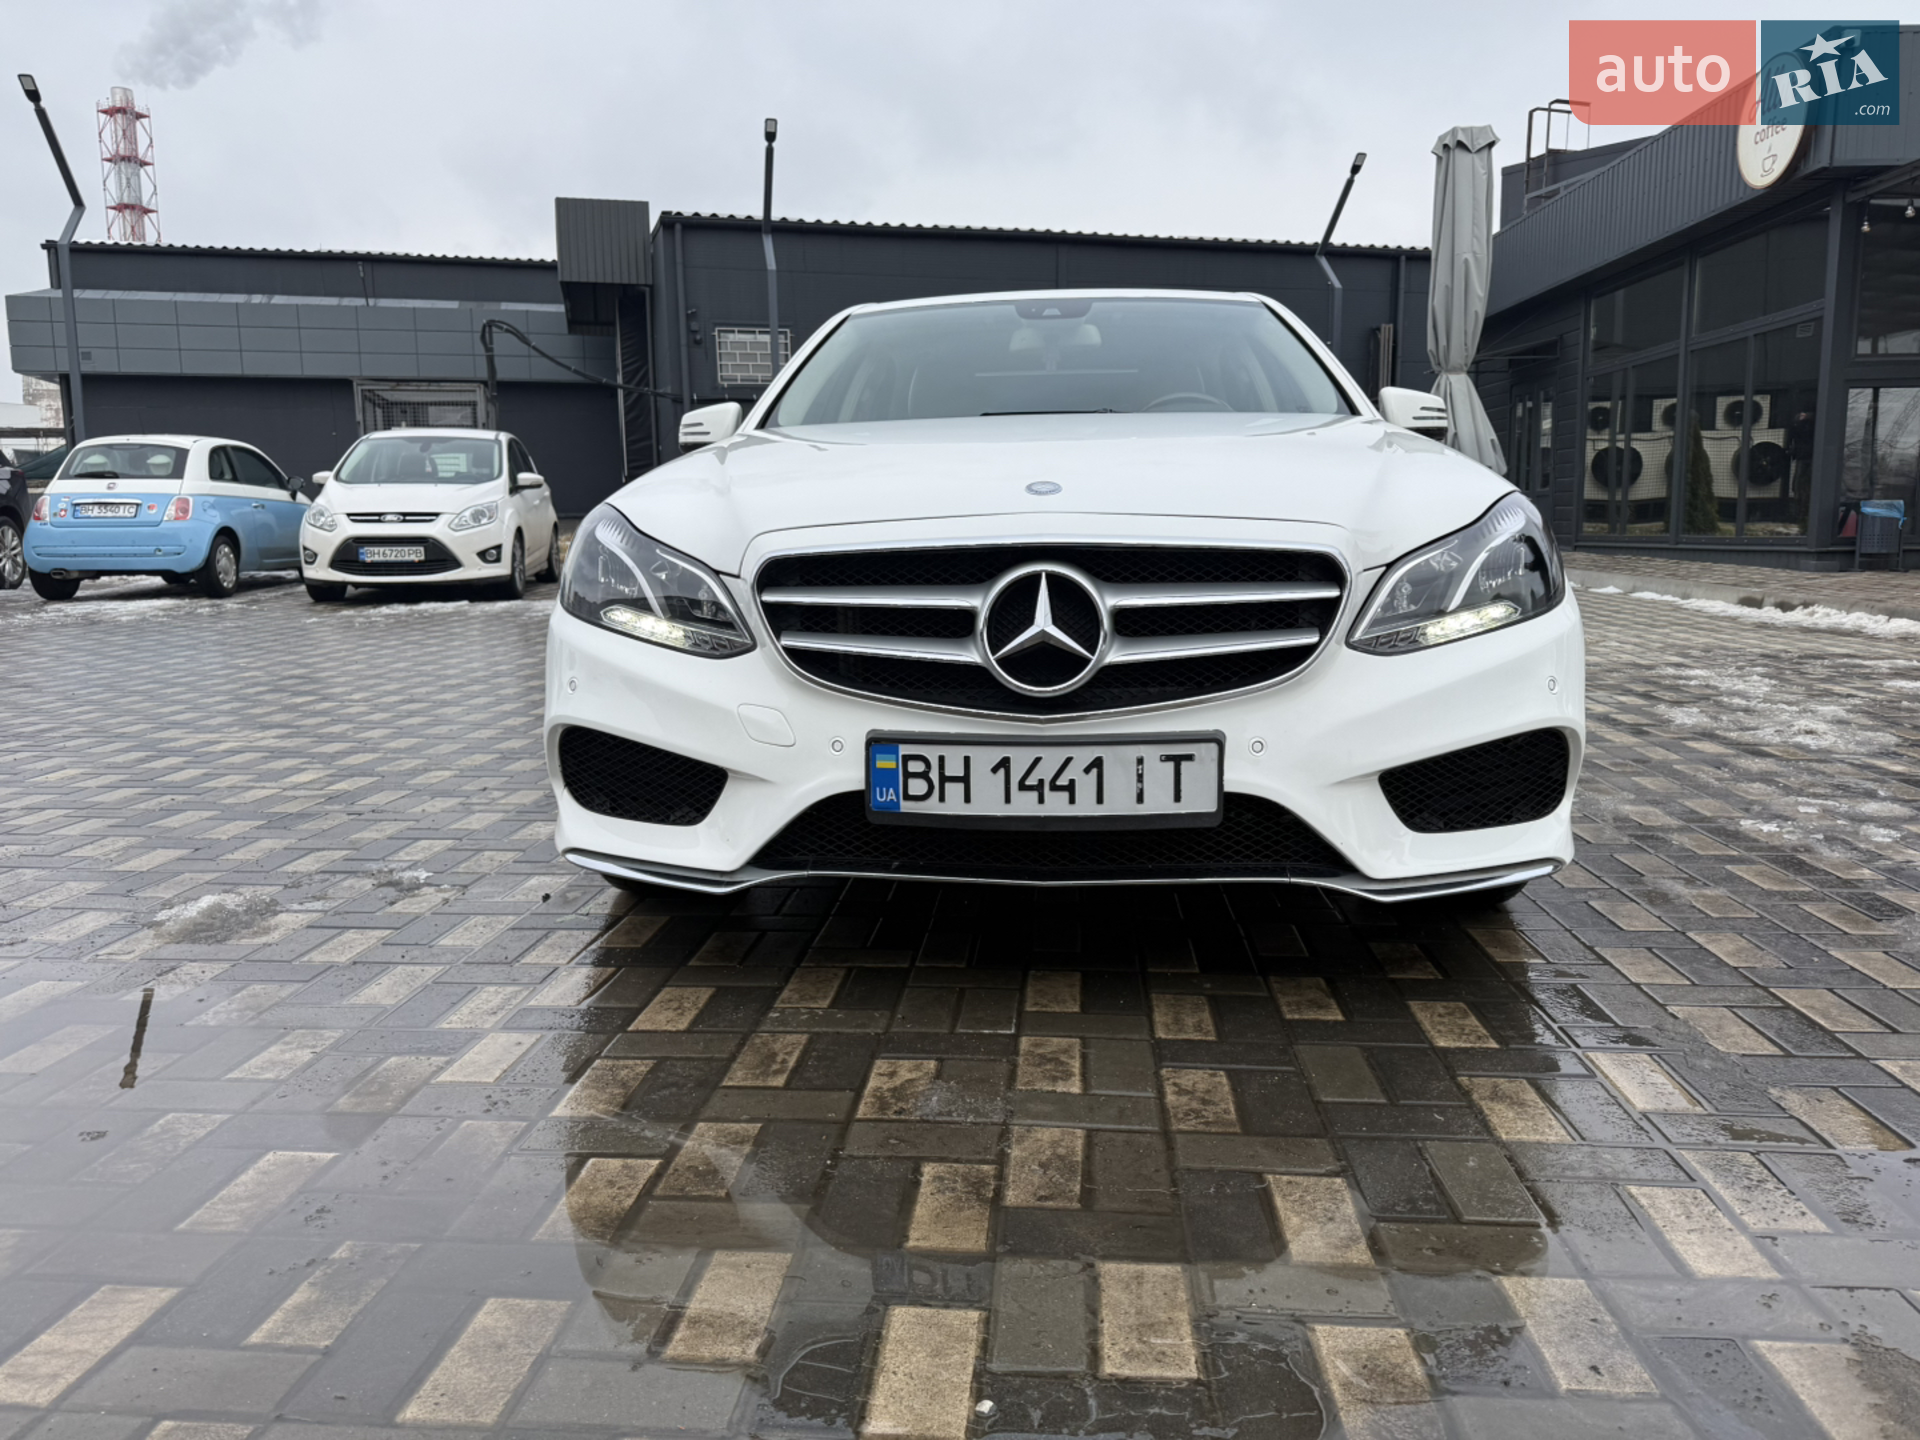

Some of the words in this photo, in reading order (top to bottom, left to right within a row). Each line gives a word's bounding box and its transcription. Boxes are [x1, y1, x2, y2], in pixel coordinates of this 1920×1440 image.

[1753, 116, 1788, 145] coffee
[901, 753, 971, 803] BH
[990, 755, 1104, 805] 1441
[1136, 753, 1196, 805] IT
[876, 787, 897, 802] UA
